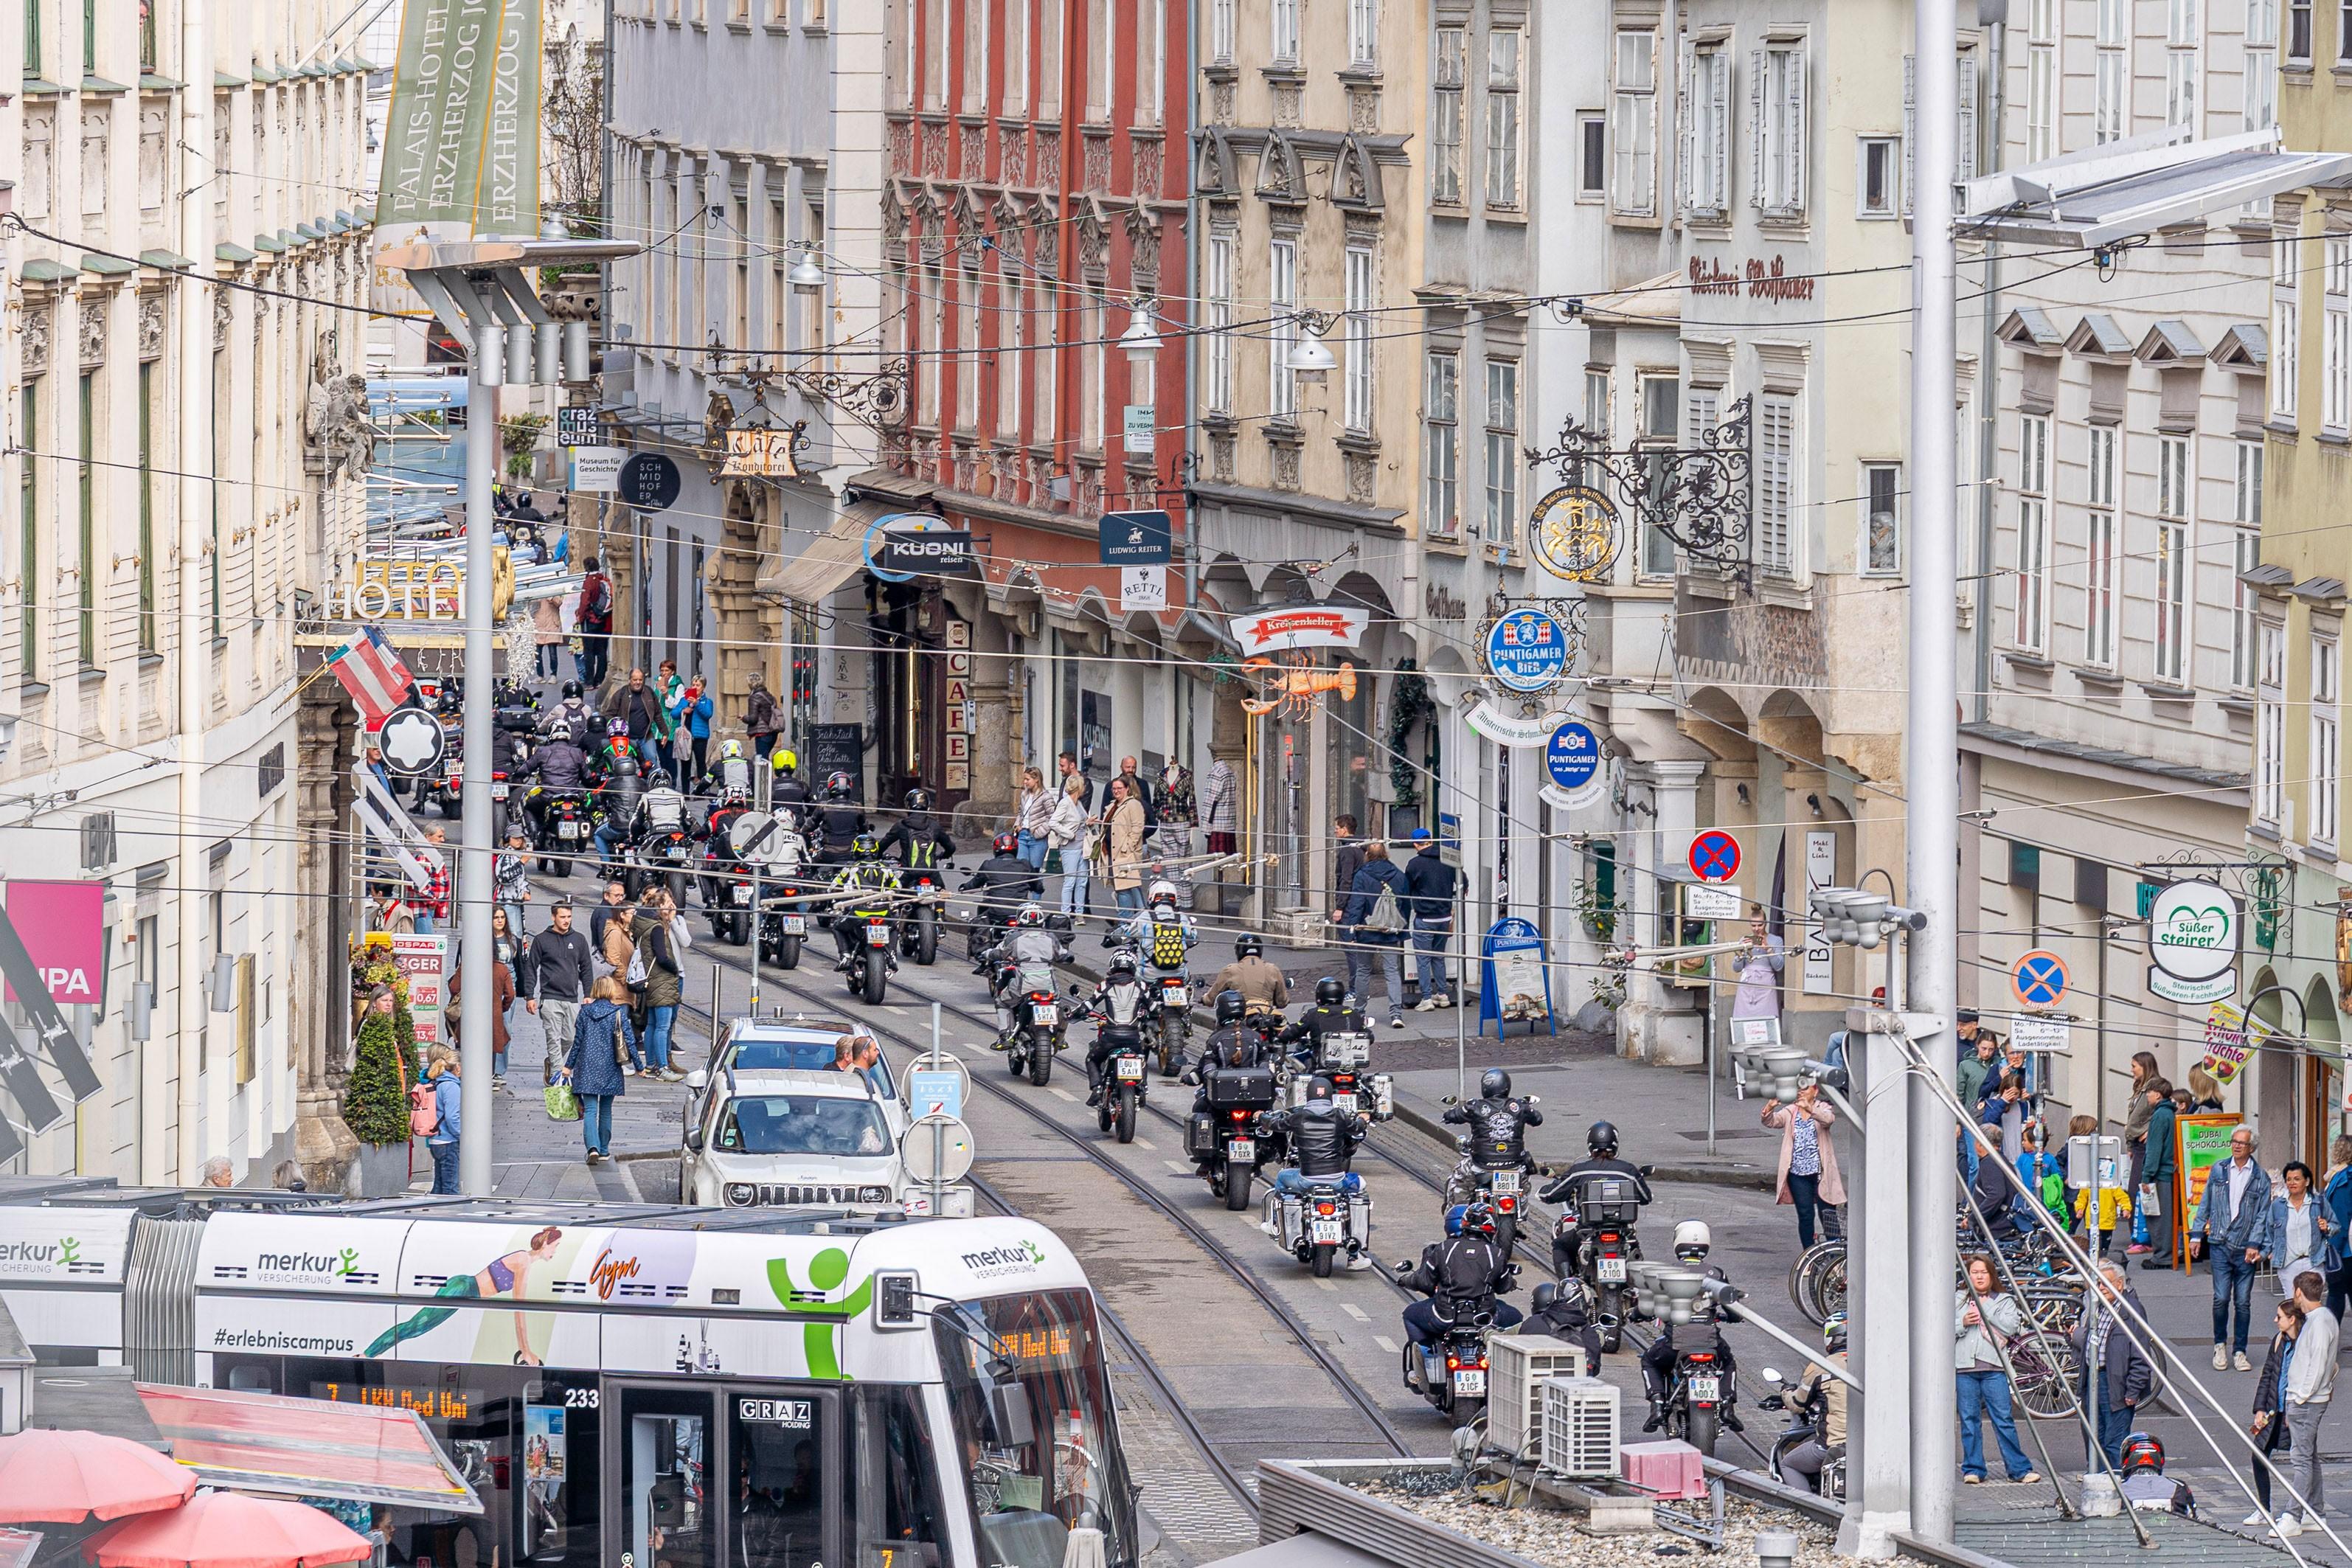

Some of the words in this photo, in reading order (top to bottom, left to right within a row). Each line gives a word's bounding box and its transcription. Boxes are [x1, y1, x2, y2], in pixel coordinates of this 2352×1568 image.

[429, 23, 480, 209] ERZHERZOG
[493, 29, 520, 223] ERZHERZOG
[639, 463, 662, 471] SCH
[639, 473, 661, 481] MID
[639, 492, 651, 500] ER
[893, 542, 964, 555] KUONI
[1138, 545, 1162, 553] REITER
[1124, 582, 1164, 597] RETTL
[1494, 648, 1562, 662] PUNTIGAMER
[1516, 662, 1541, 673] BIER
[1550, 755, 1596, 763] PUNTIGAMER
[2179, 922, 2214, 933] Süßer
[2161, 934, 2215, 948] Steirer
[2152, 982, 2234, 1000] Süßwaren-Fachhandel
[2172, 981, 2213, 991] Steirischer
[416, 993, 437, 1005] 0,67
[2199, 1131, 2221, 1139] DUBAI
[1500, 1173, 1509, 1182] GU
[258, 1252, 337, 1272] merkur
[961, 1246, 1029, 1269] merkur
[257, 1272, 331, 1285] VERSICHERUNG
[589, 1248, 641, 1300] Gym
[974, 1264, 1036, 1280] VERSICHERUNG
[214, 1328, 353, 1355] #erlebniscampus
[1465, 1373, 1470, 1381] G
[1699, 1381, 1704, 1389] G
[565, 1388, 600, 1409] 233
[440, 1392, 468, 1419] Uni
[740, 1401, 810, 1420] GRAZ
[782, 1420, 811, 1429] HOLDING
